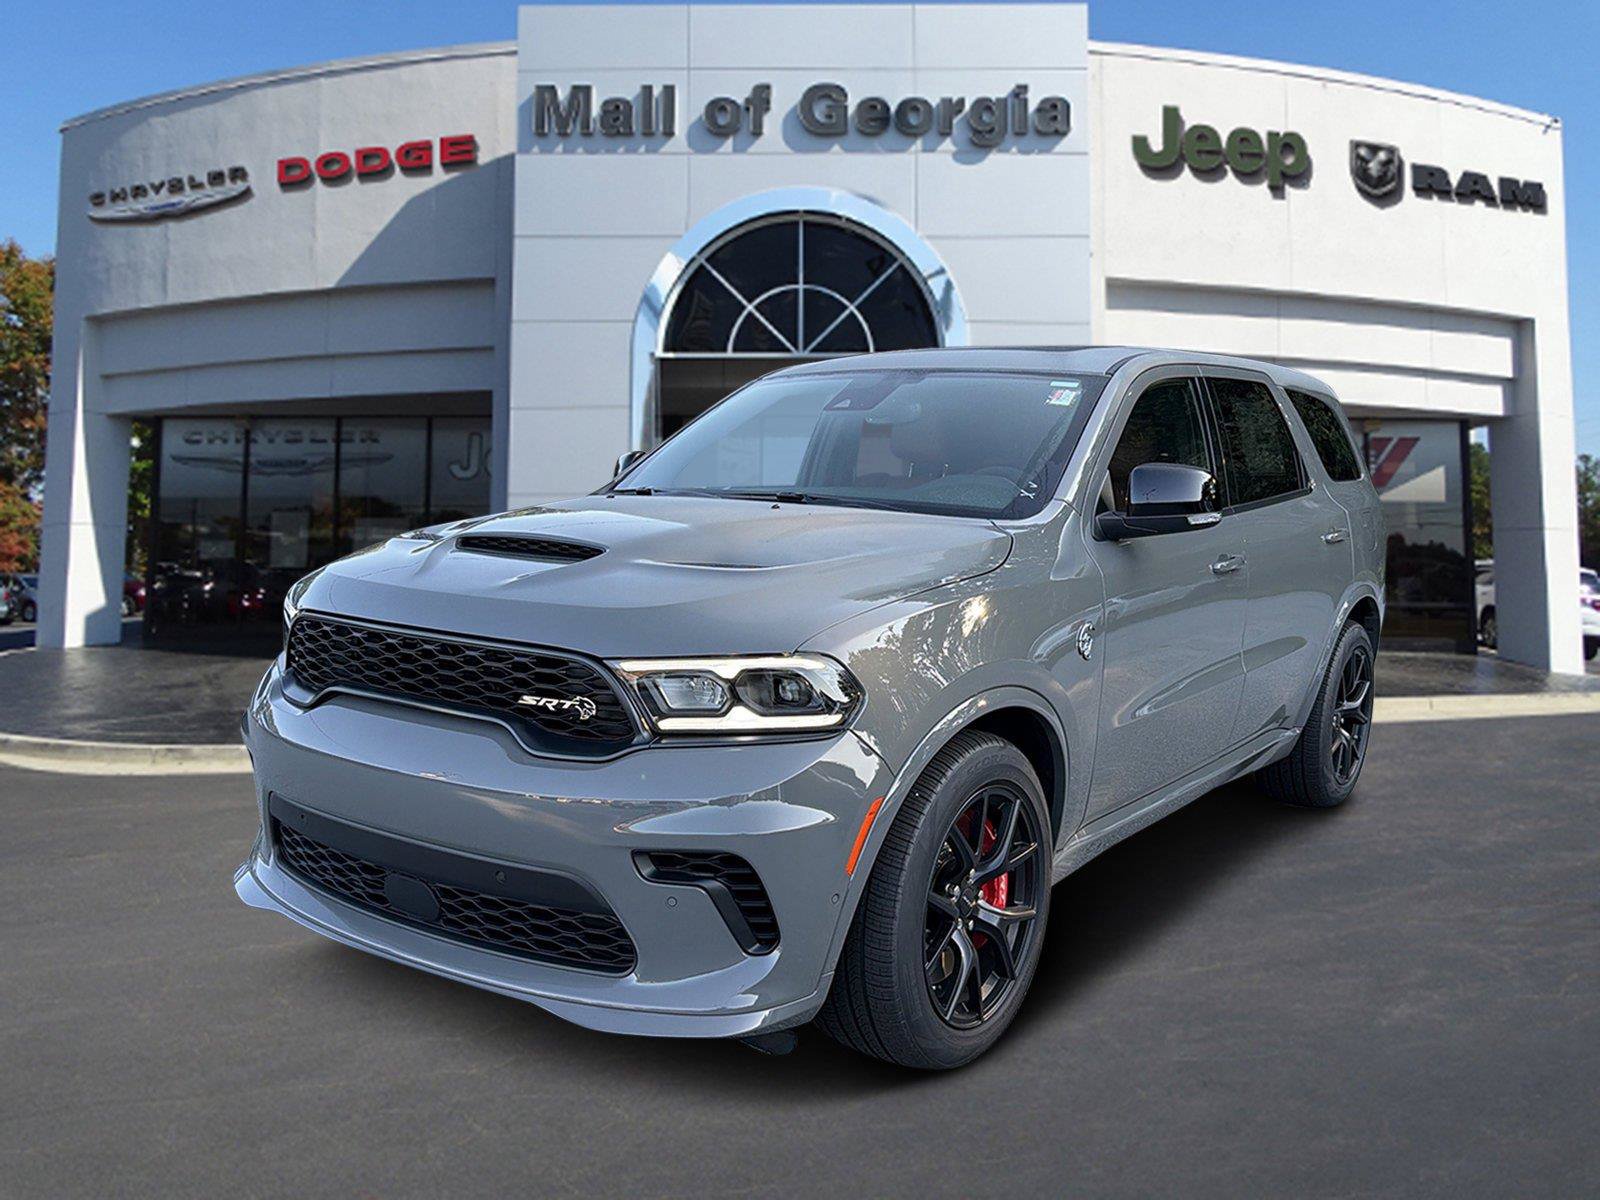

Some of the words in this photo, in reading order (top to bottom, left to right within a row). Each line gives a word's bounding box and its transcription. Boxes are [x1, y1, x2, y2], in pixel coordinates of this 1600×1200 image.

[534, 84, 676, 137] Mall
[703, 83, 772, 137] of
[800, 82, 1071, 148] Georgia
[277, 134, 475, 185] DODGE
[1132, 105, 1308, 188] Jeep
[89, 166, 249, 207] CHRYSLER
[1411, 162, 1546, 208] RAM
[518, 695, 580, 711] SRT
